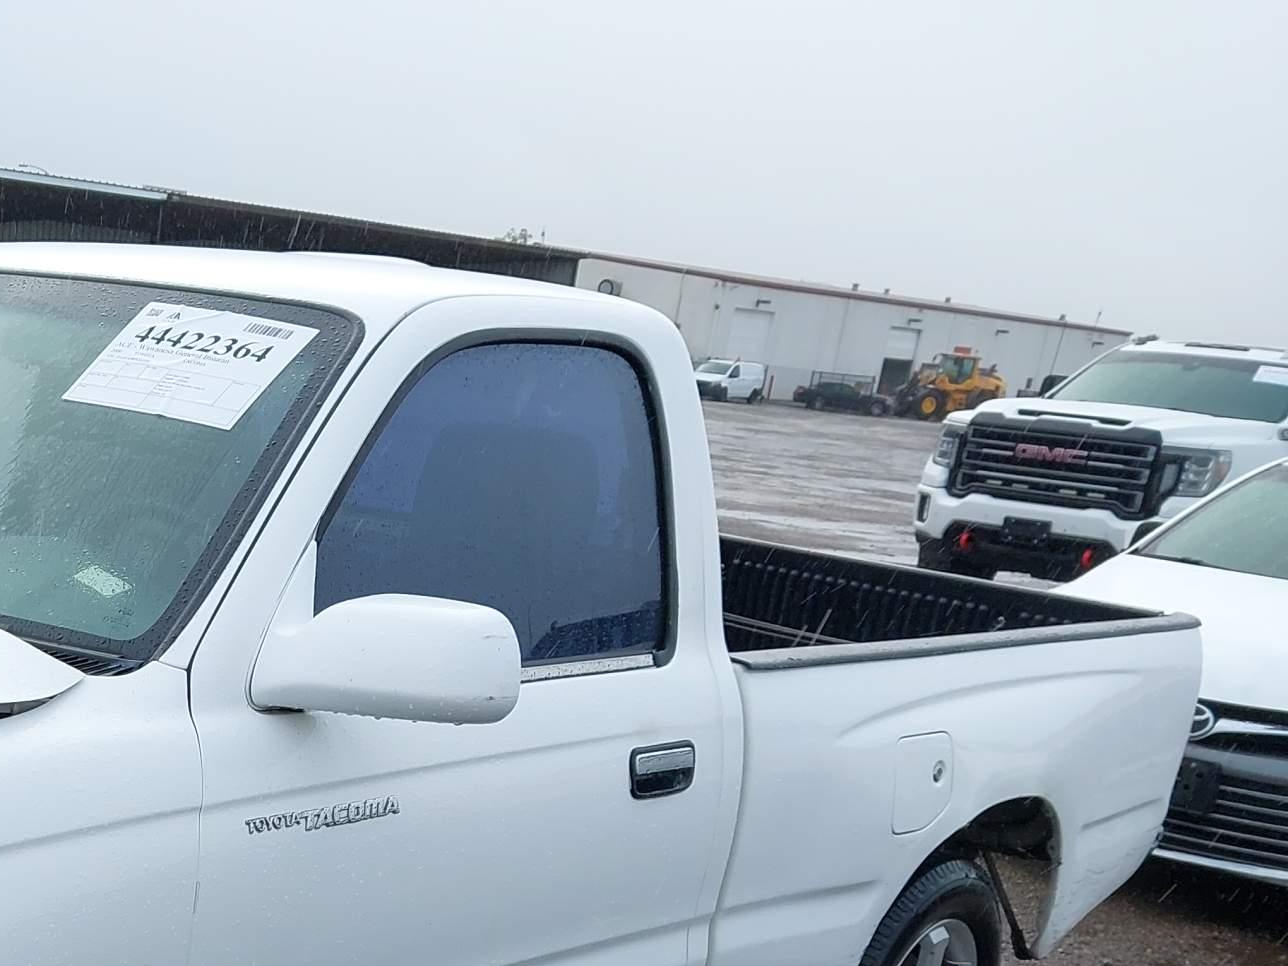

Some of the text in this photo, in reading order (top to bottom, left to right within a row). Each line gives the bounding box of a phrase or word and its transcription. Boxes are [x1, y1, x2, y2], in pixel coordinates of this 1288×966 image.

[135, 325, 274, 362] 44422364
[1016, 443, 1089, 465] GMC
[245, 795, 400, 835] TOYOTA TACOMA
